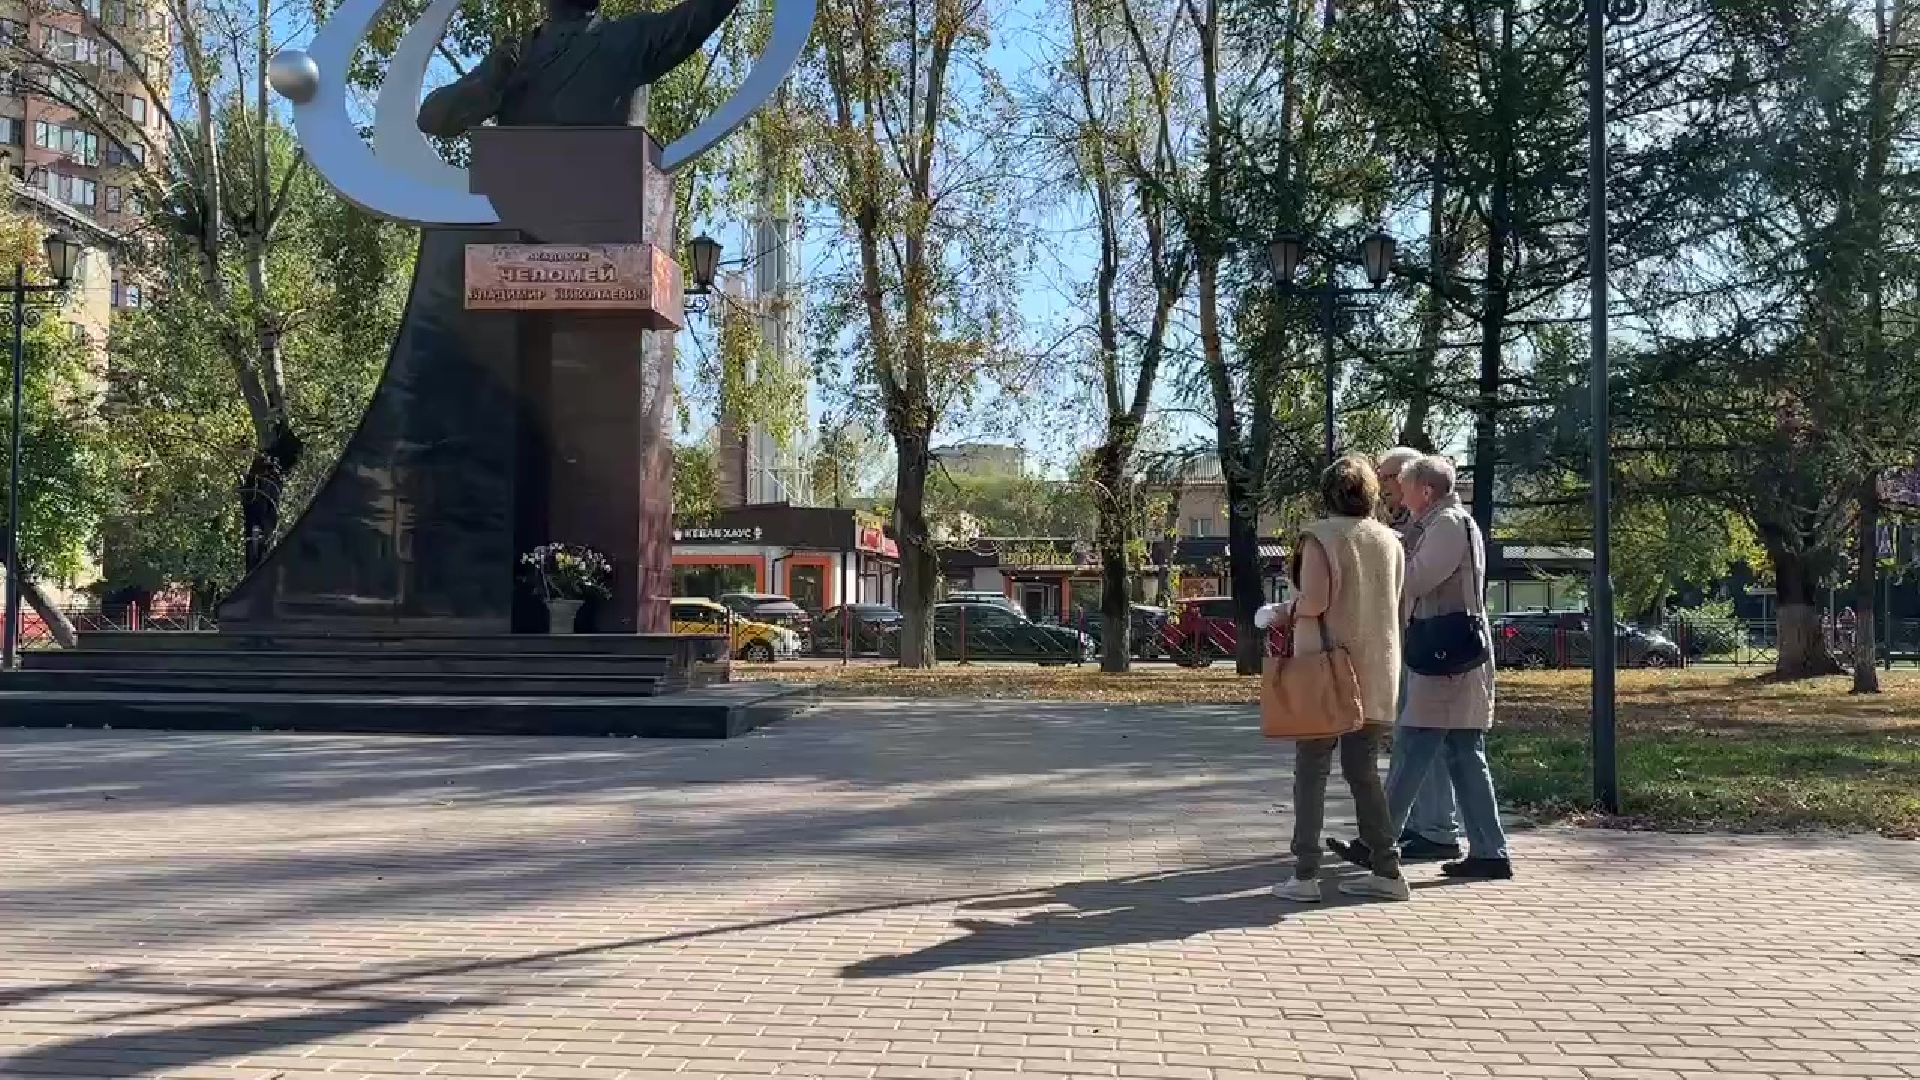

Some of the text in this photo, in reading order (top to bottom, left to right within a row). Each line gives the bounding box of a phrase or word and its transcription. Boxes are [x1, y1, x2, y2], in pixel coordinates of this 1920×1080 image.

[499, 264, 618, 283] ЧЕЛОМЕЙ
[467, 287, 648, 302] ВЛАДИМИР НИКОЛАЕВИЧ
